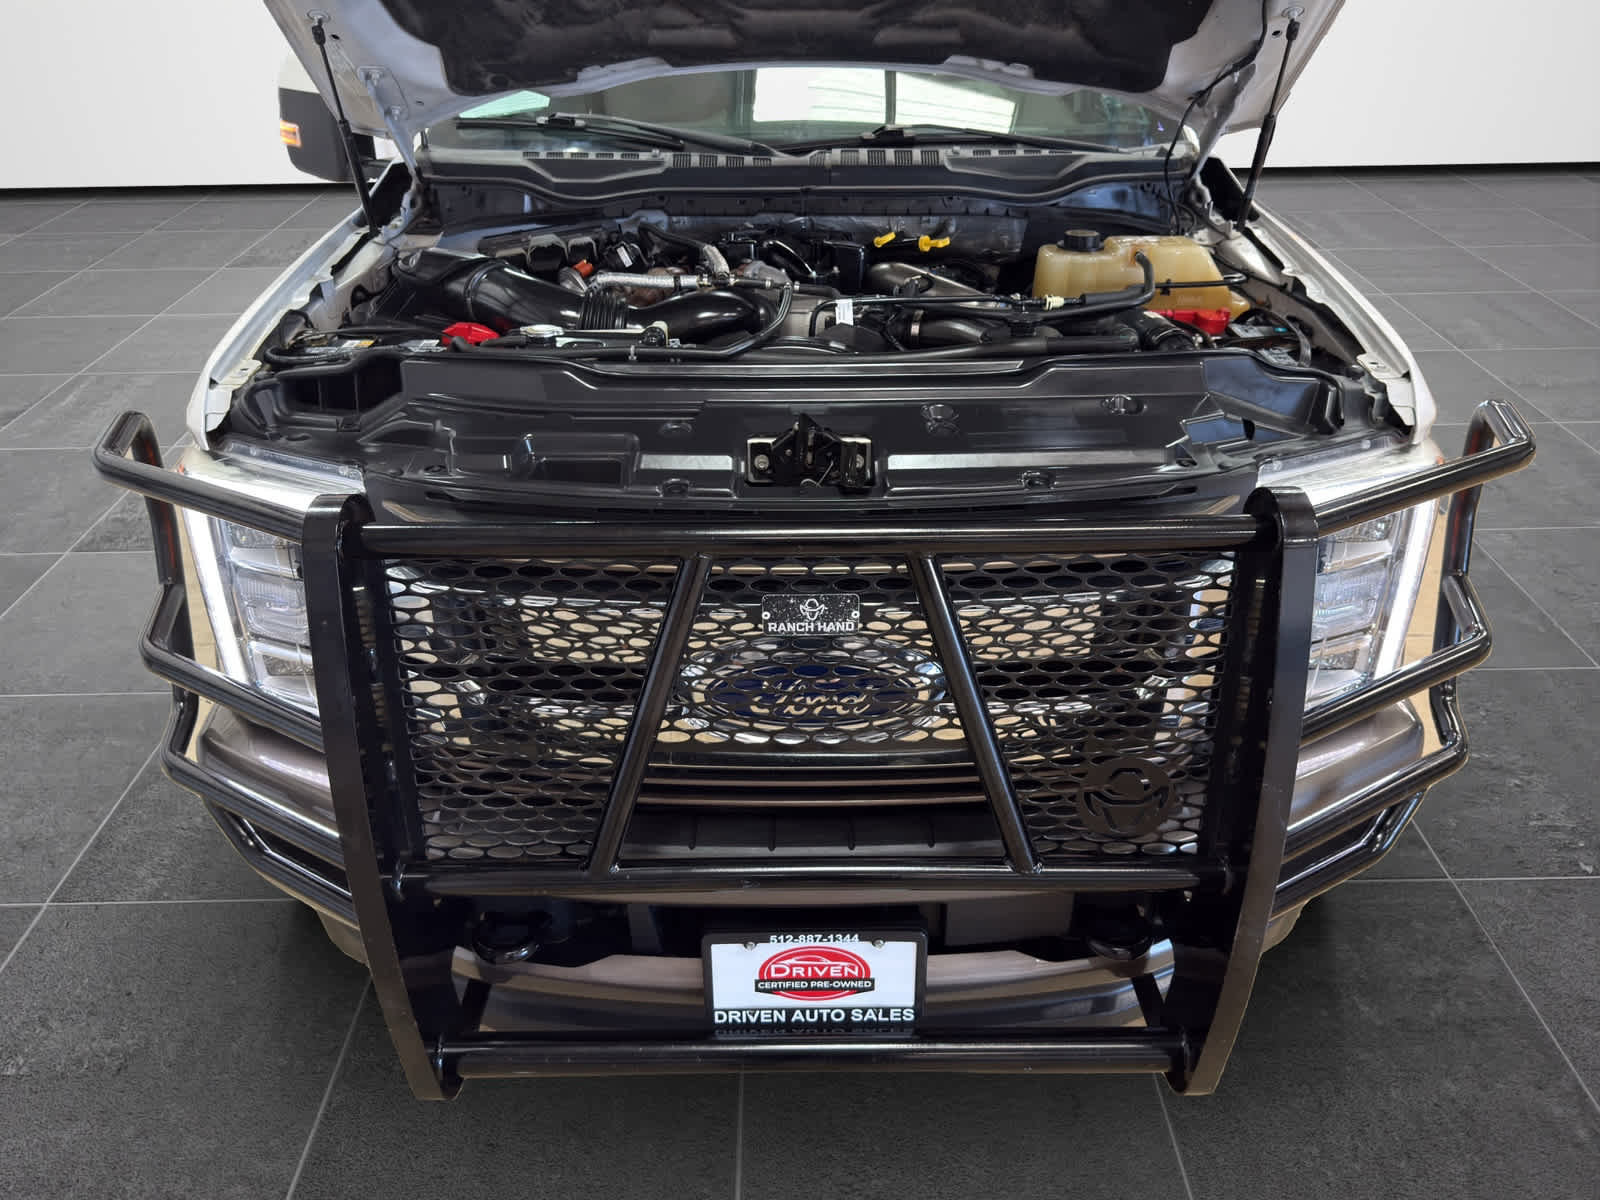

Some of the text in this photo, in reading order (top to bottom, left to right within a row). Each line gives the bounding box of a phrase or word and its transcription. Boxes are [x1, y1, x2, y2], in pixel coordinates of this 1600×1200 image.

[767, 621, 856, 633] RANCH HAND
[769, 934, 860, 944] 512-887-1344
[770, 964, 859, 977] DRIVEN
[757, 981, 872, 989] CERTIFIED PRE-OWNED
[713, 1008, 915, 1023] DRIVEN AUTO SALES
